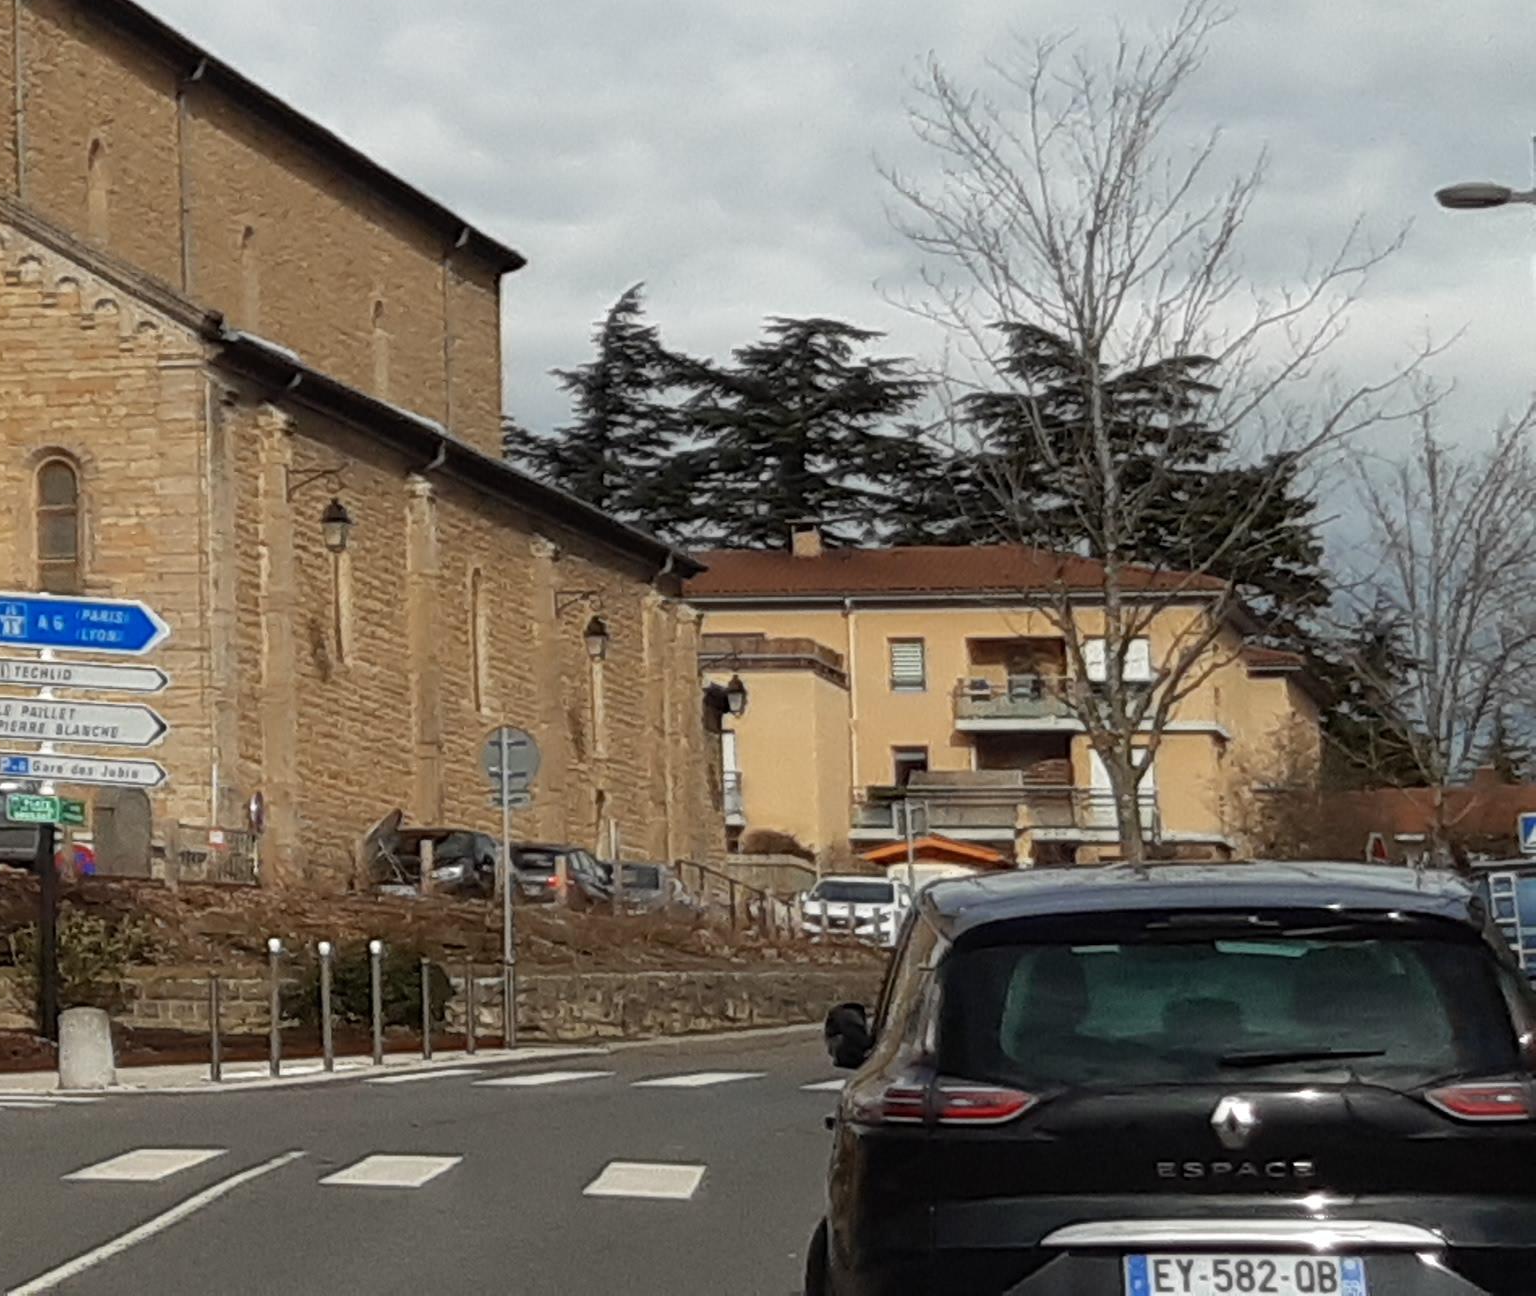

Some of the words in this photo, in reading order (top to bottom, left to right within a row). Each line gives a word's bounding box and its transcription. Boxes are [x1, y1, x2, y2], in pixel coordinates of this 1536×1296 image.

[38, 614, 48, 630] A
[15, 666, 72, 680] TECHLID
[22, 705, 76, 720] PAILLET
[55, 723, 118, 738] BLANCHE
[32, 760, 63, 774] Gare
[1157, 1162, 1315, 1178] ESPACE
[1153, 1259, 1338, 1294] EY-582-QB
